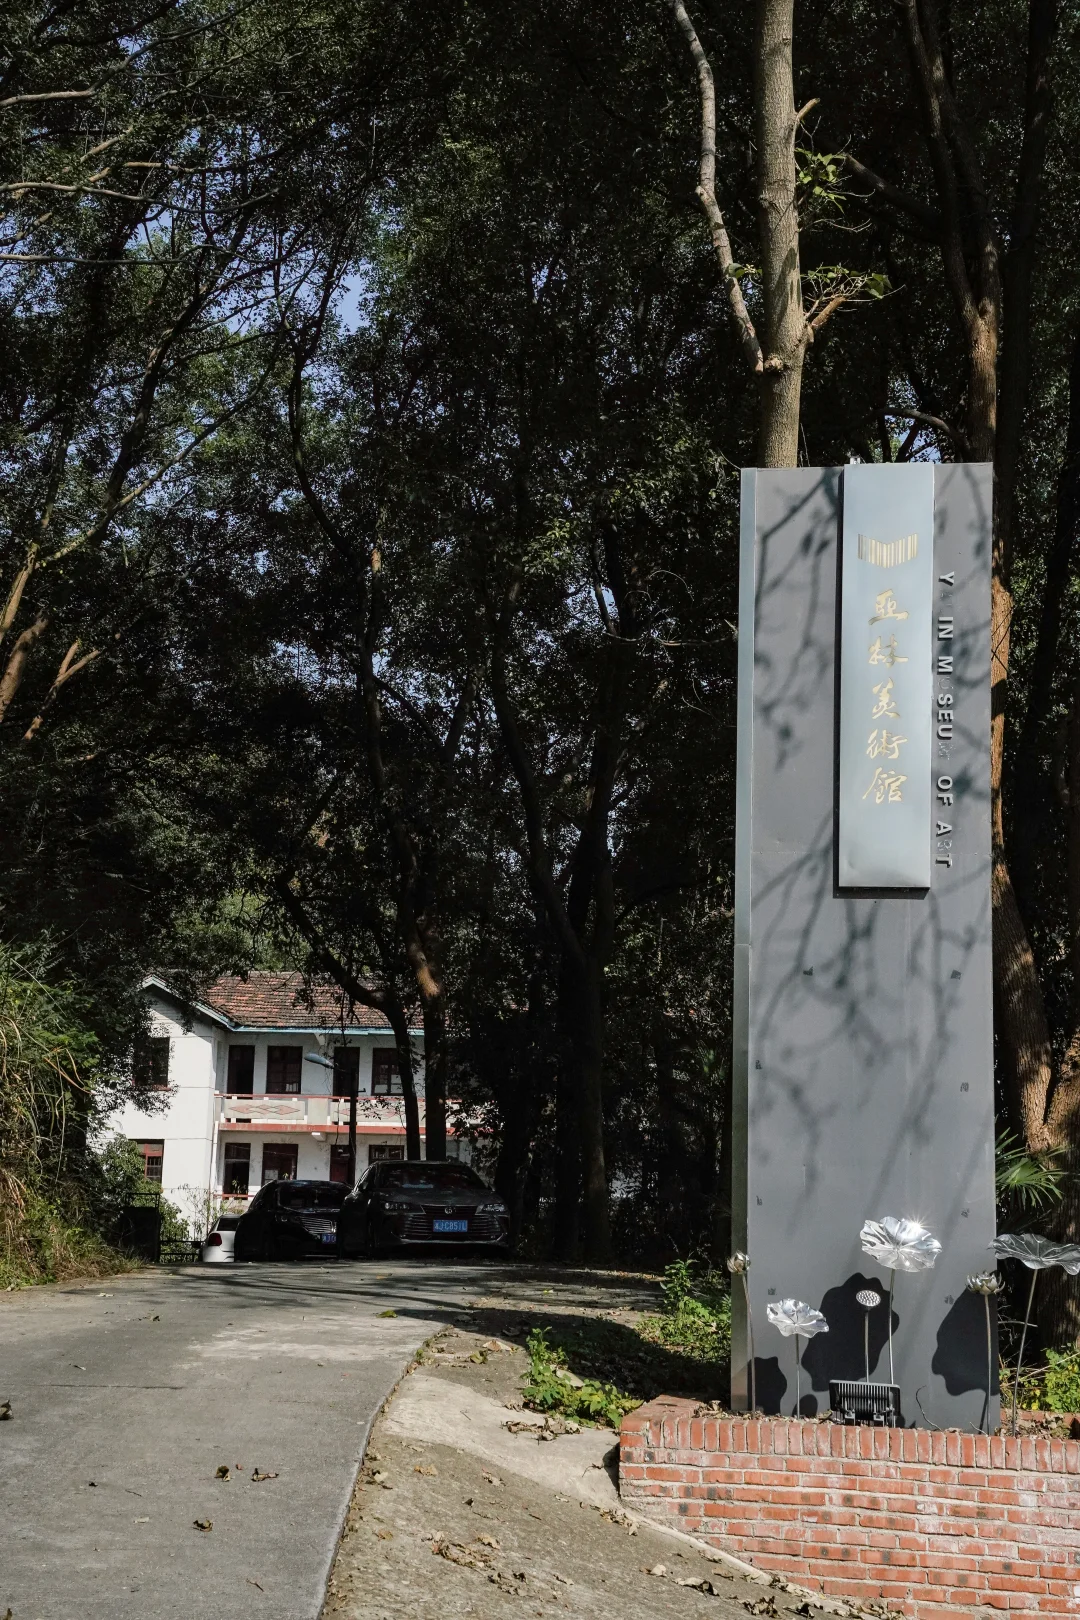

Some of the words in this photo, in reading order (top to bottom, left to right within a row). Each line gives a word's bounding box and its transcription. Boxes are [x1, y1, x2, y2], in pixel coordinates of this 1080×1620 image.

[938, 571, 955, 639] YIN
[938, 656, 955, 760] MSEU
[937, 775, 954, 805] OF
